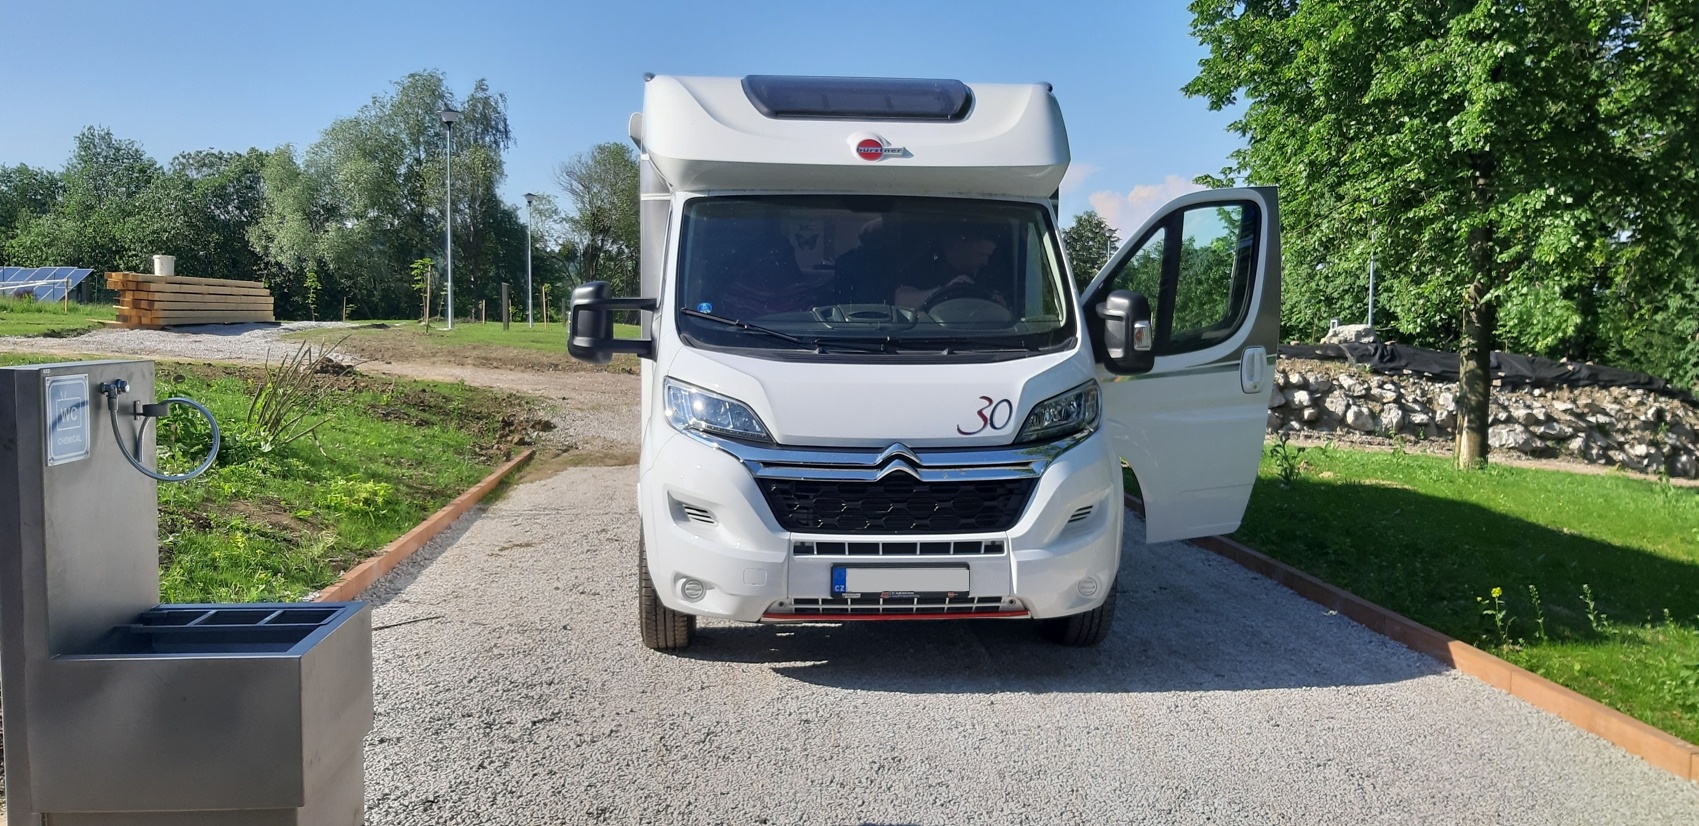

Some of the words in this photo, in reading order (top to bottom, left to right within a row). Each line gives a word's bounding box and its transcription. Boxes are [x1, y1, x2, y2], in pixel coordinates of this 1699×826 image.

[60, 406, 78, 422] WC
[957, 396, 1013, 435] 30
[58, 434, 82, 445] CHEMICAL
